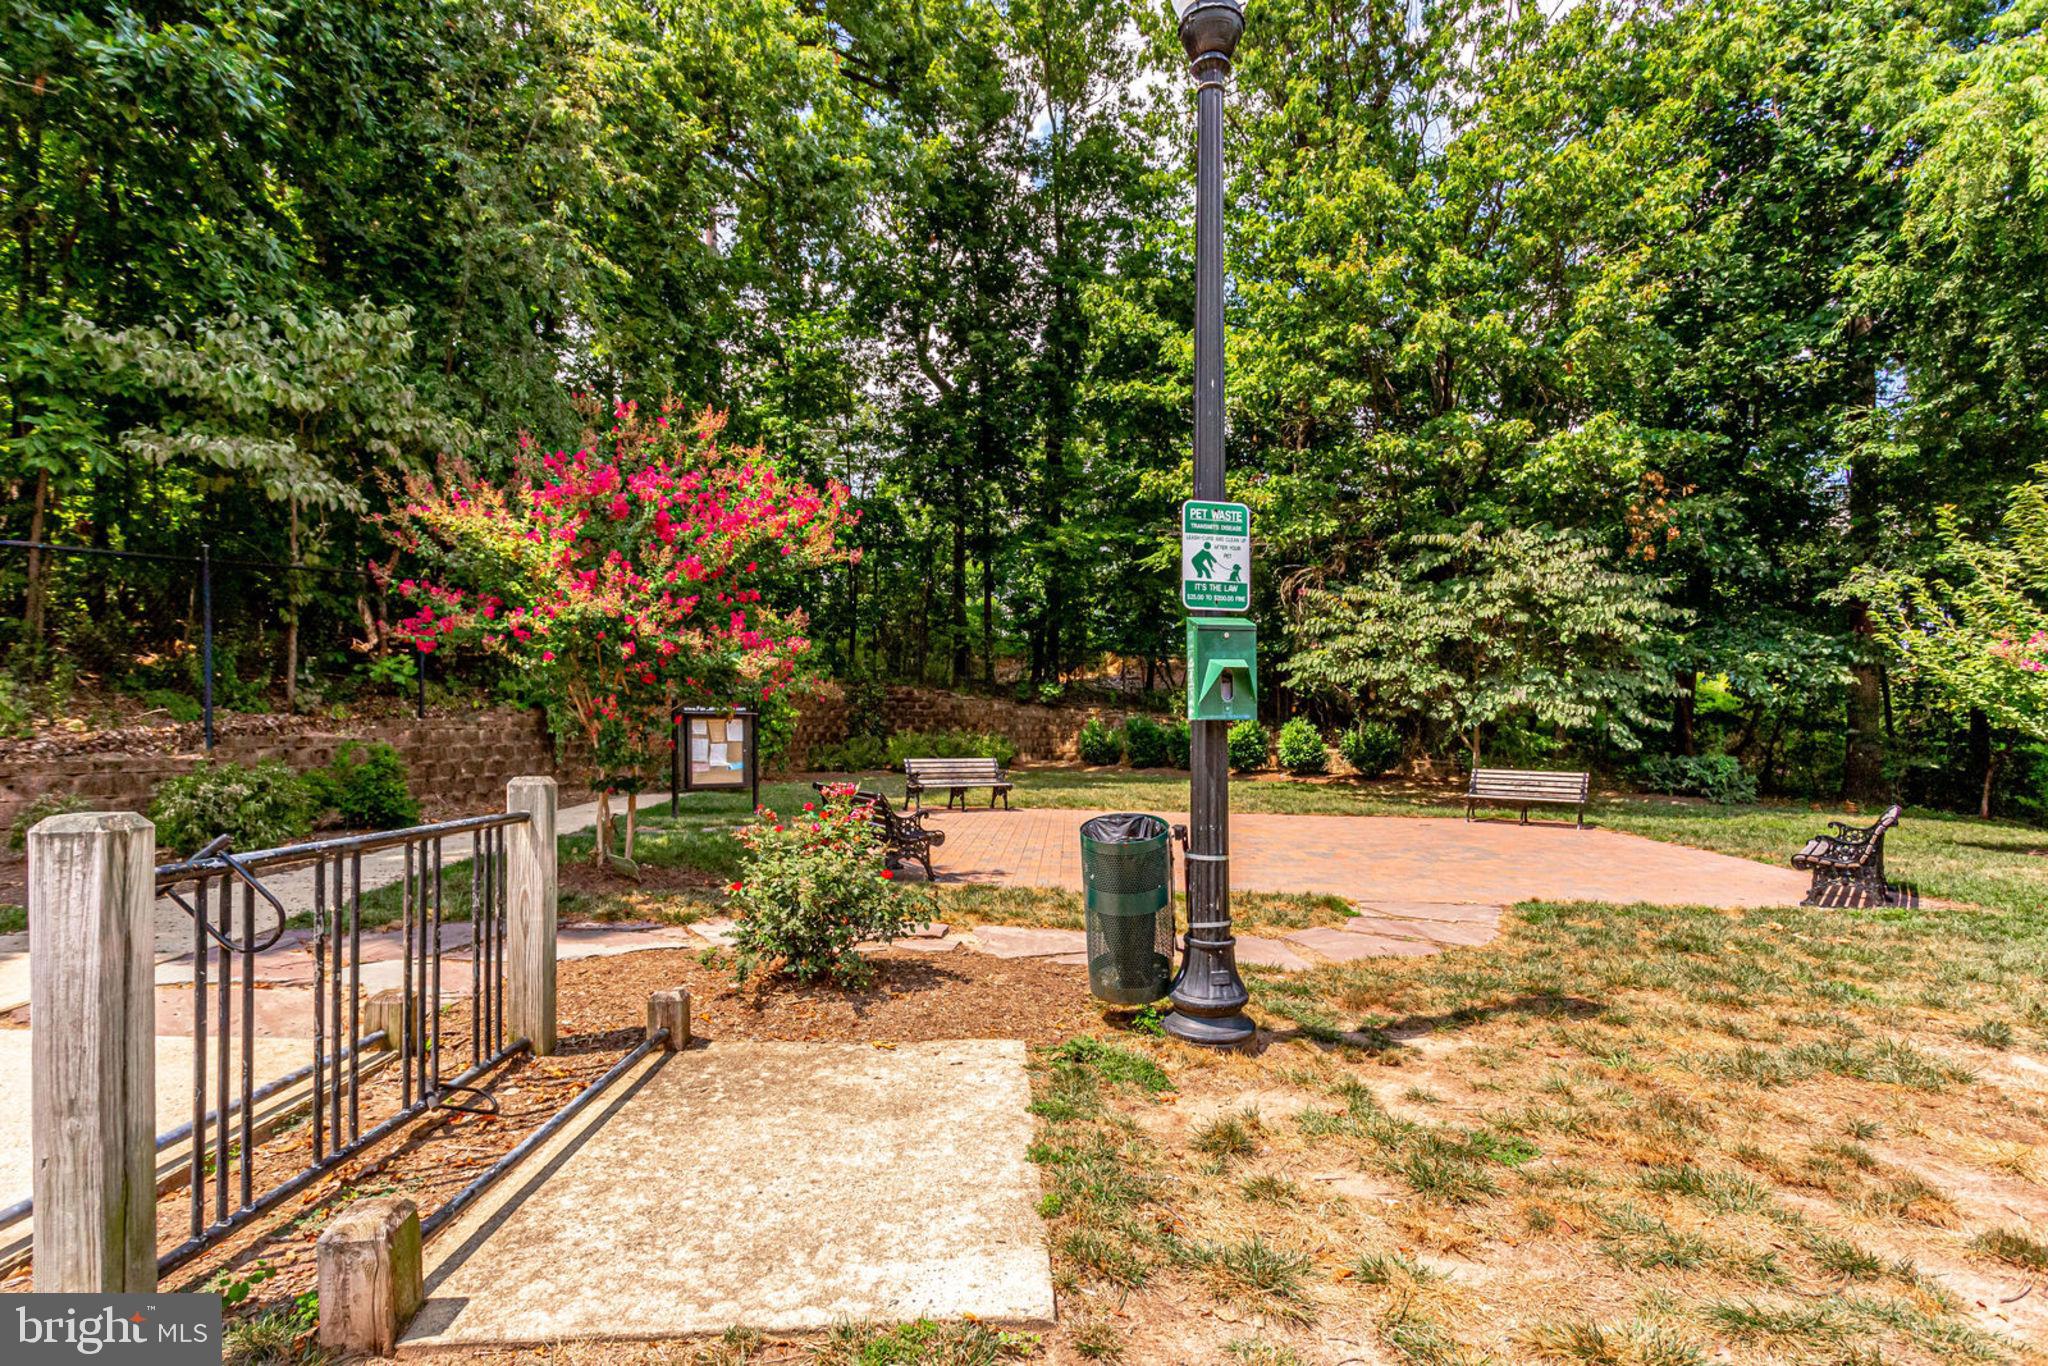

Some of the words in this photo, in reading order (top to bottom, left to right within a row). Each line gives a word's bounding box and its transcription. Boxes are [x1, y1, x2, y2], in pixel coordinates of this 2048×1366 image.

[1190, 508, 1208, 520] PET
[1211, 509, 1243, 523] WASTE
[1194, 583, 1207, 591] IT'S
[1209, 584, 1222, 592] THE
[1223, 584, 1239, 592] LAW
